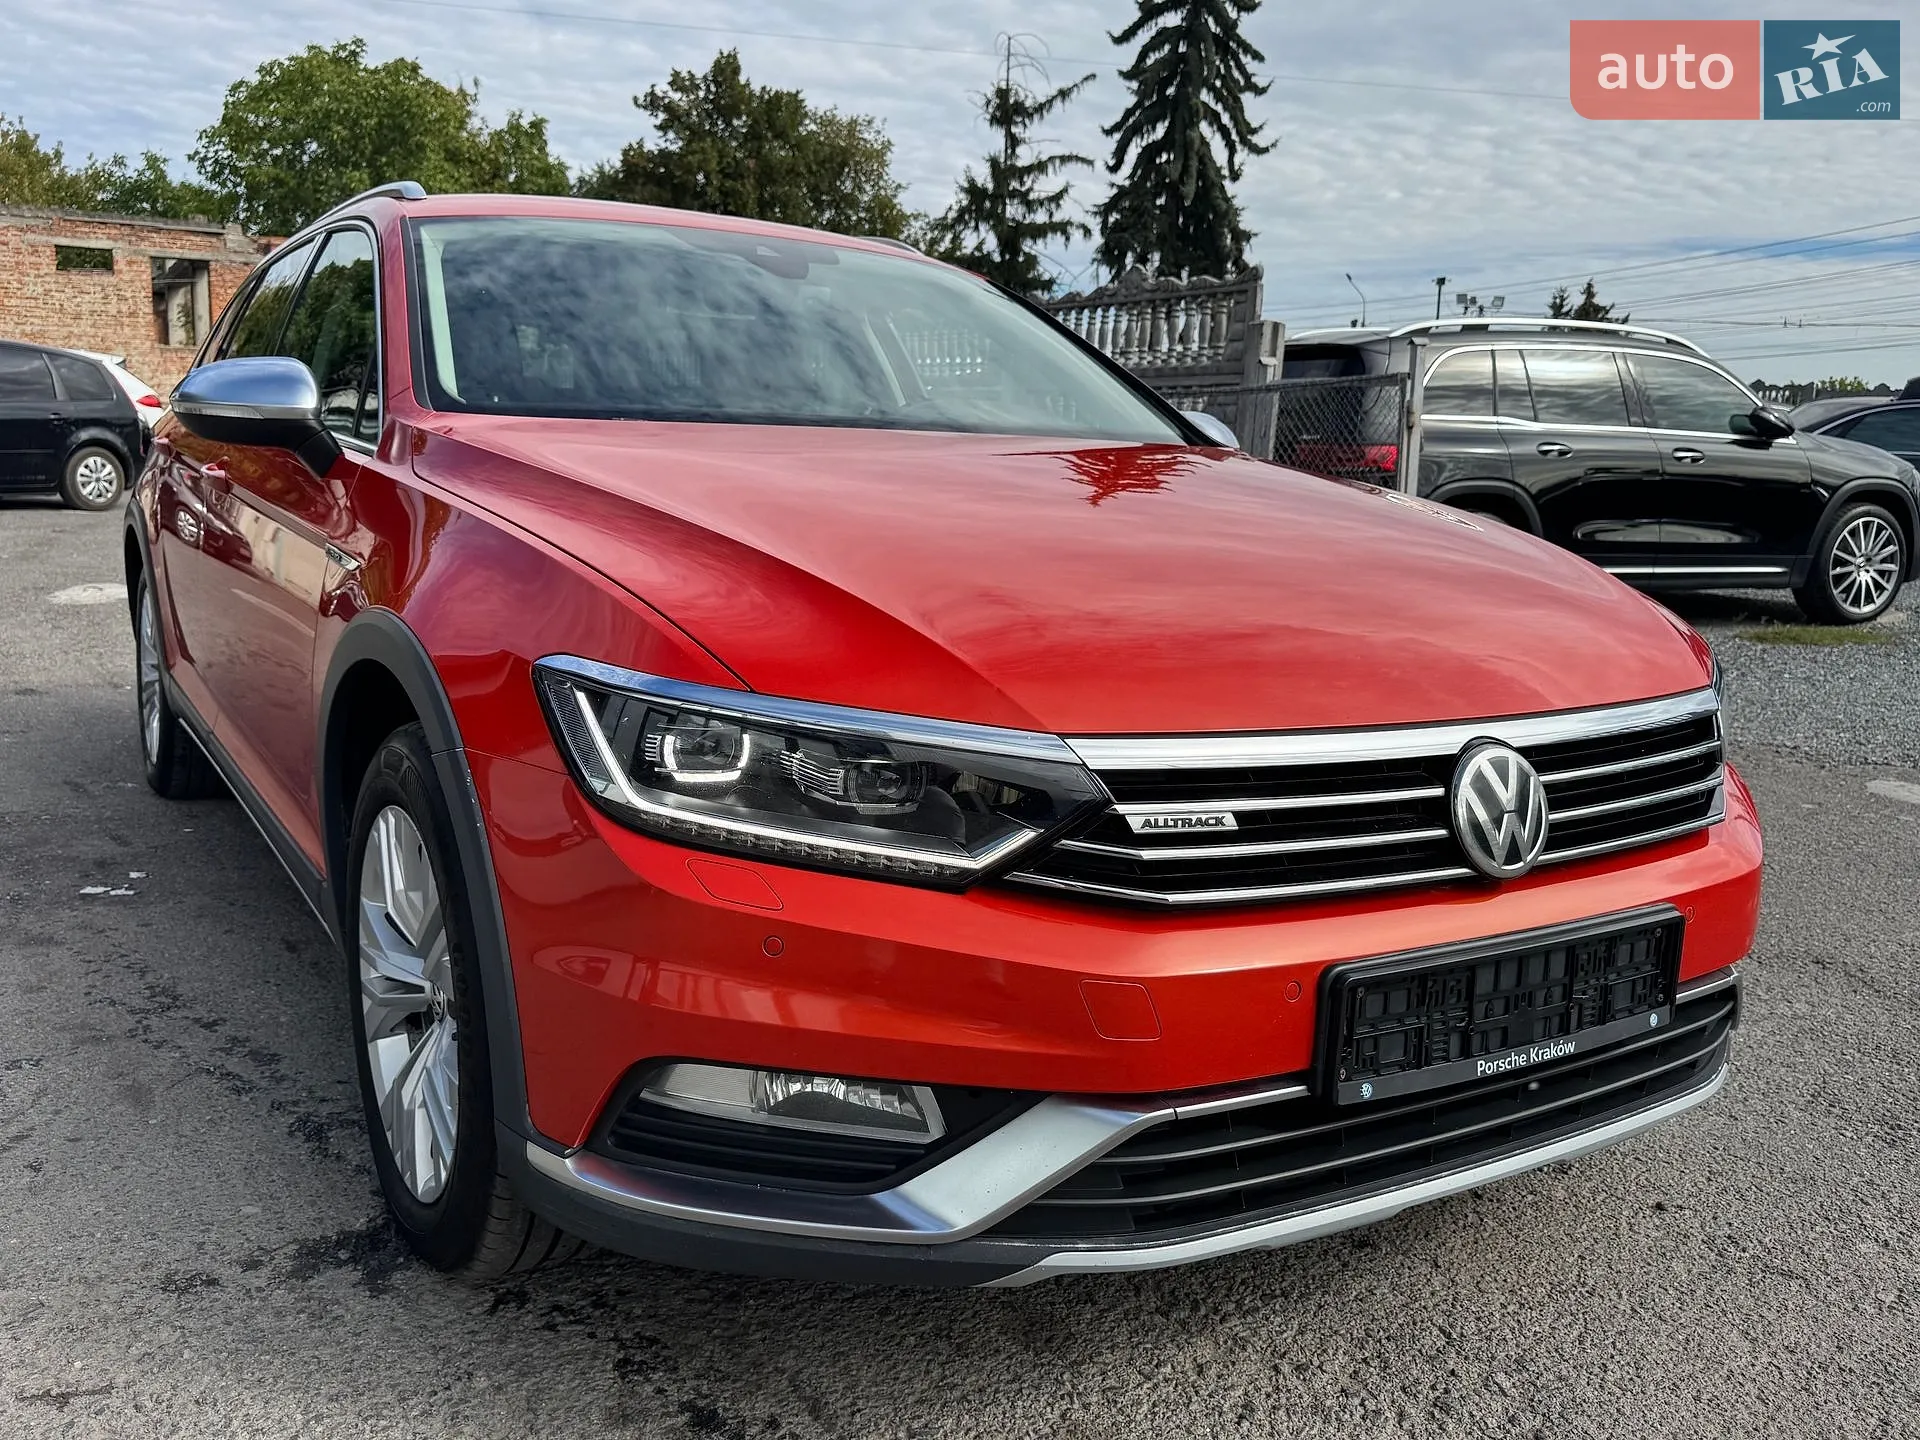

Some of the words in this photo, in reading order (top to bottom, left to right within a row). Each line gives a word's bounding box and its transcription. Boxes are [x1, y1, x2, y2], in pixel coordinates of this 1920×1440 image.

[1140, 815, 1226, 829] ALLTRACK
[1460, 750, 1545, 872] VW
[1477, 1052, 1527, 1076] Porsche
[1530, 1040, 1576, 1063] Kraków
